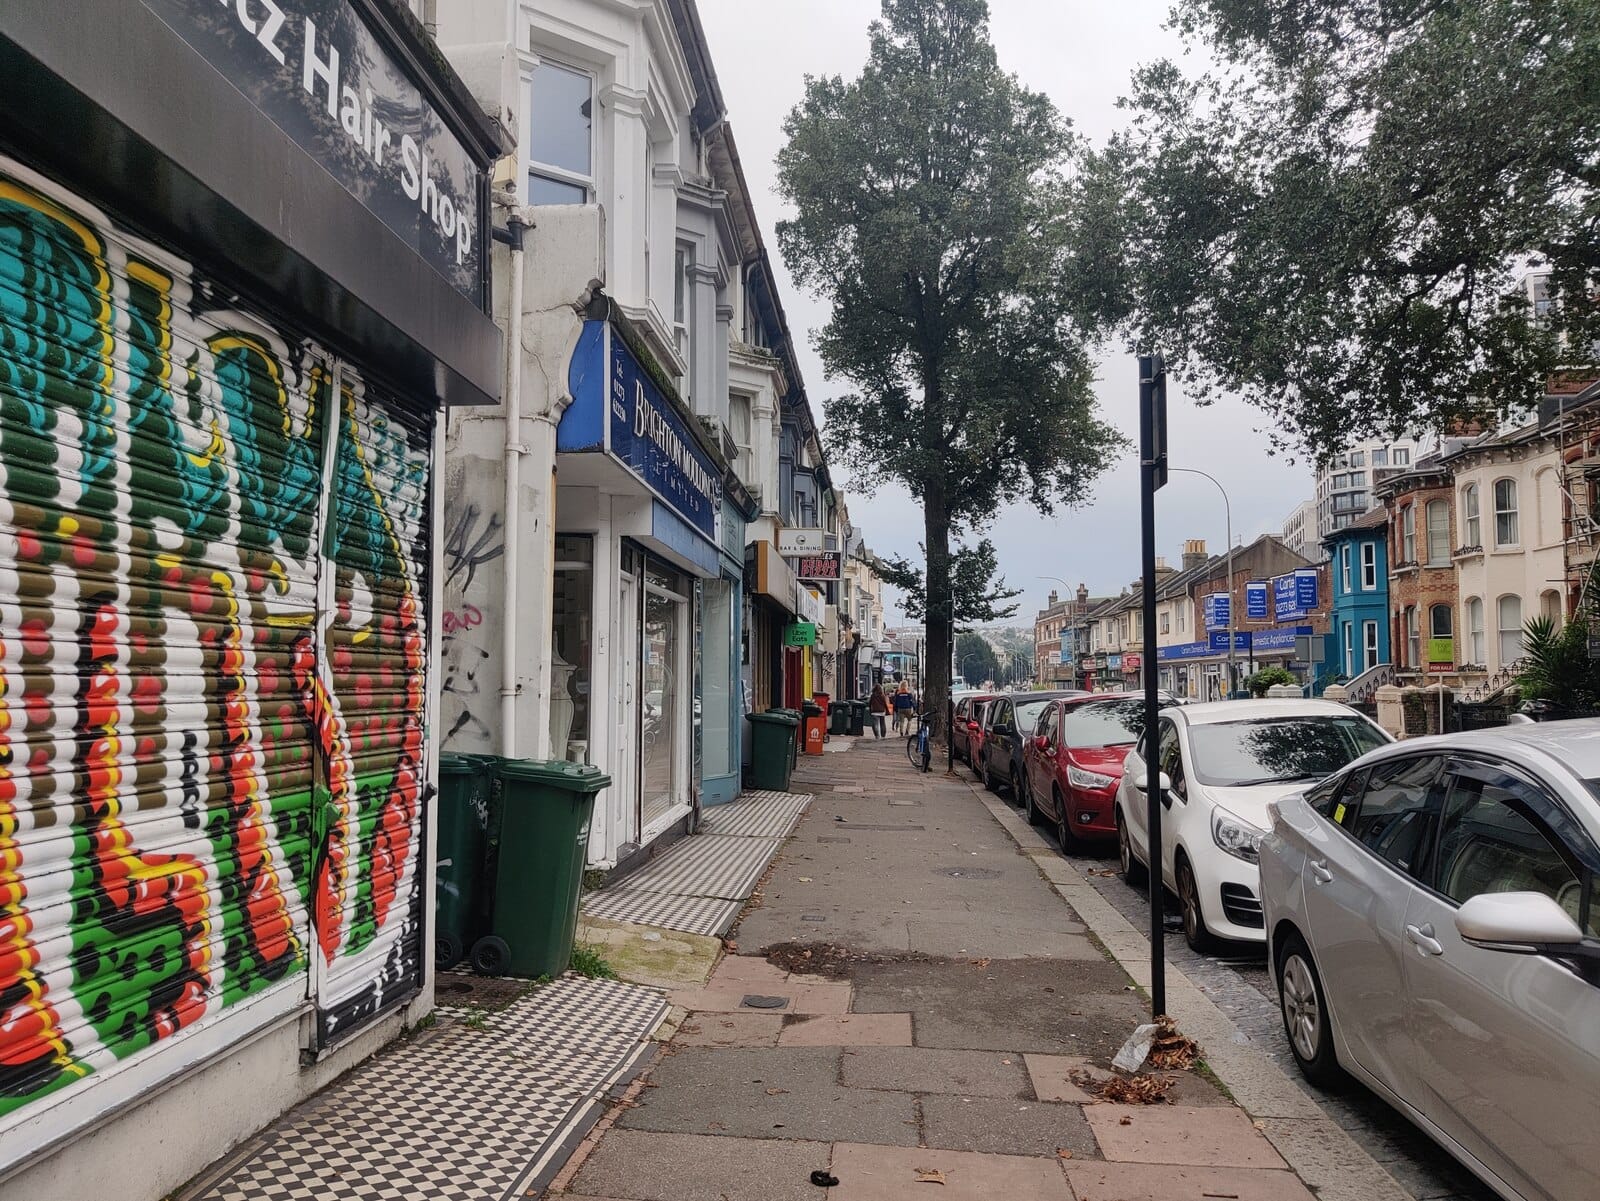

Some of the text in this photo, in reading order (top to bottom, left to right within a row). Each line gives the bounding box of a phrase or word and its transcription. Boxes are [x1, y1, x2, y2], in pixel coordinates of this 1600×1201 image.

[303, 15, 392, 167] Hair
[400, 133, 472, 266] Shop
[634, 379, 683, 468] BRIGHTON
[801, 559, 838, 569] KEBAB
[801, 567, 837, 578] PIZZA
[1279, 577, 1295, 591] Carte
